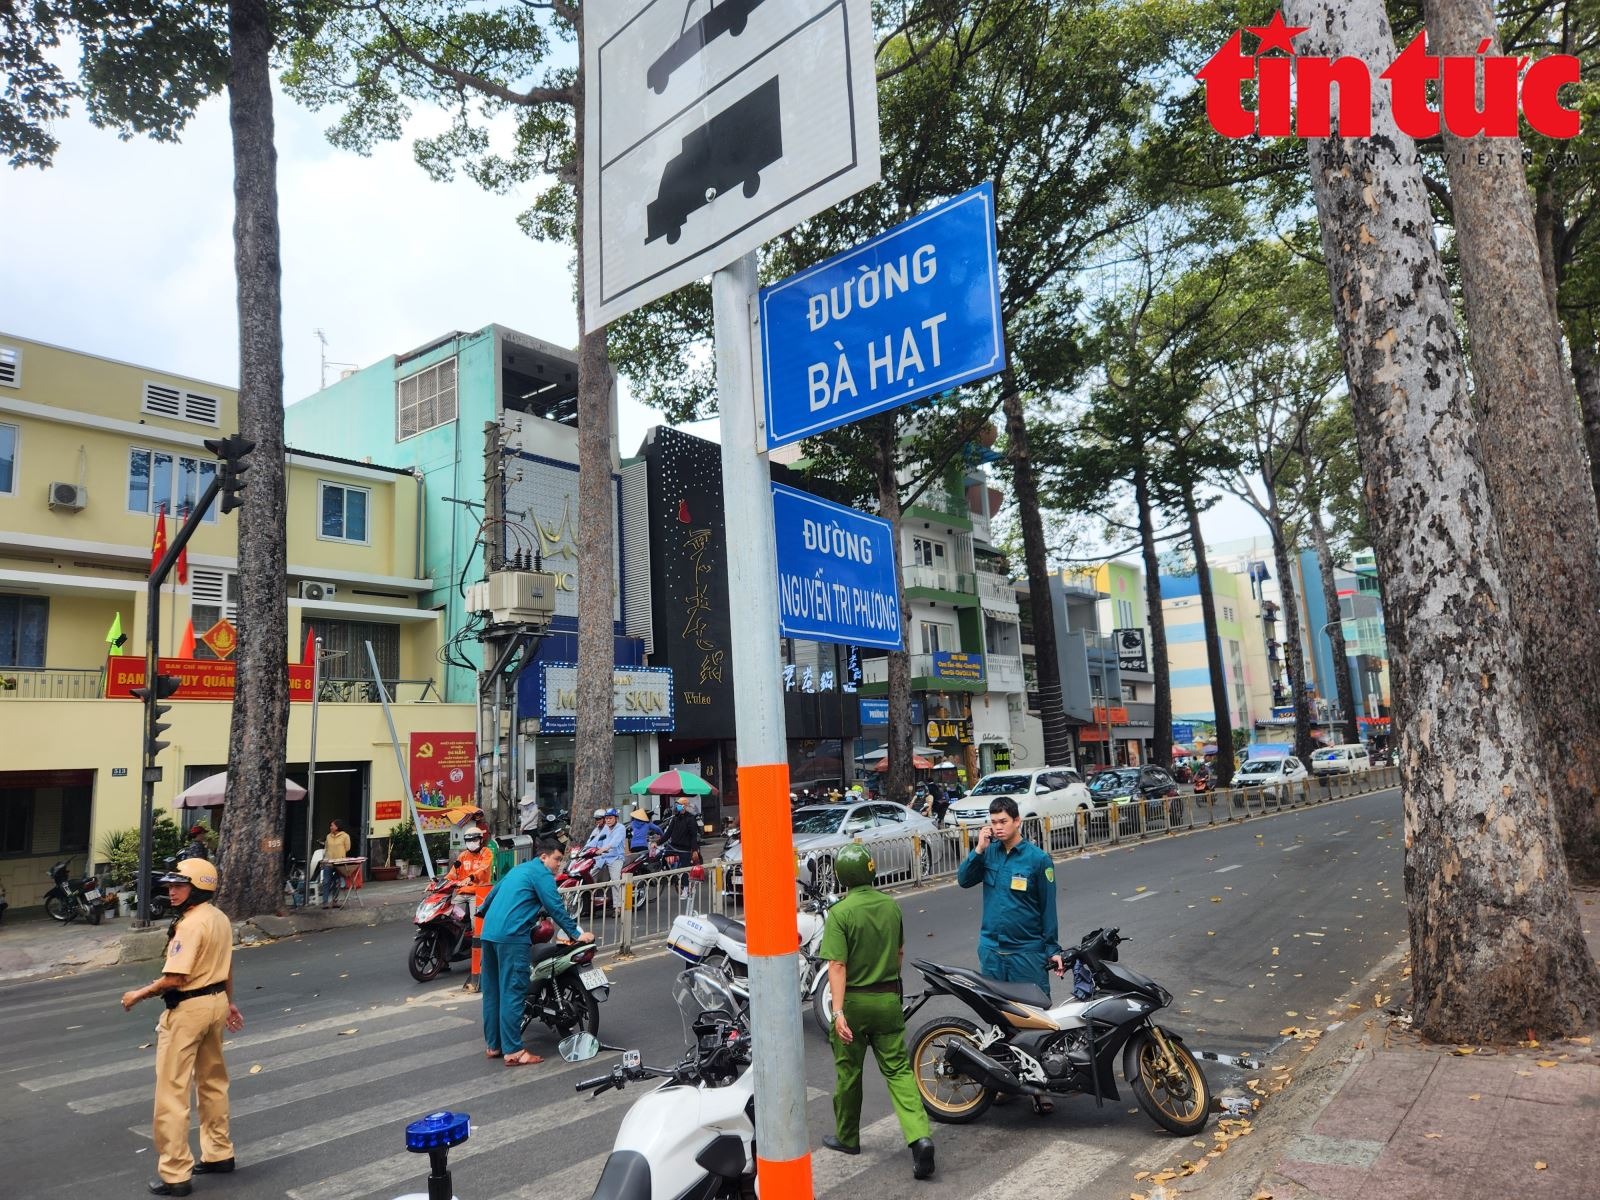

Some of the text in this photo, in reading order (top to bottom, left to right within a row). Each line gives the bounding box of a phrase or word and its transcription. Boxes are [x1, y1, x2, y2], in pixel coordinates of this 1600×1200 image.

[806, 243, 938, 333] ĐƯỜNG
[807, 312, 948, 413] BÀ HẠT
[802, 518, 873, 565] ĐƯỜNG
[780, 567, 833, 622] NGUYỄN
[853, 586, 898, 632] PHƯƠNG
[117, 672, 145, 685] BAN
[304, 679, 312, 690] 8
[625, 690, 664, 714] SKIN
